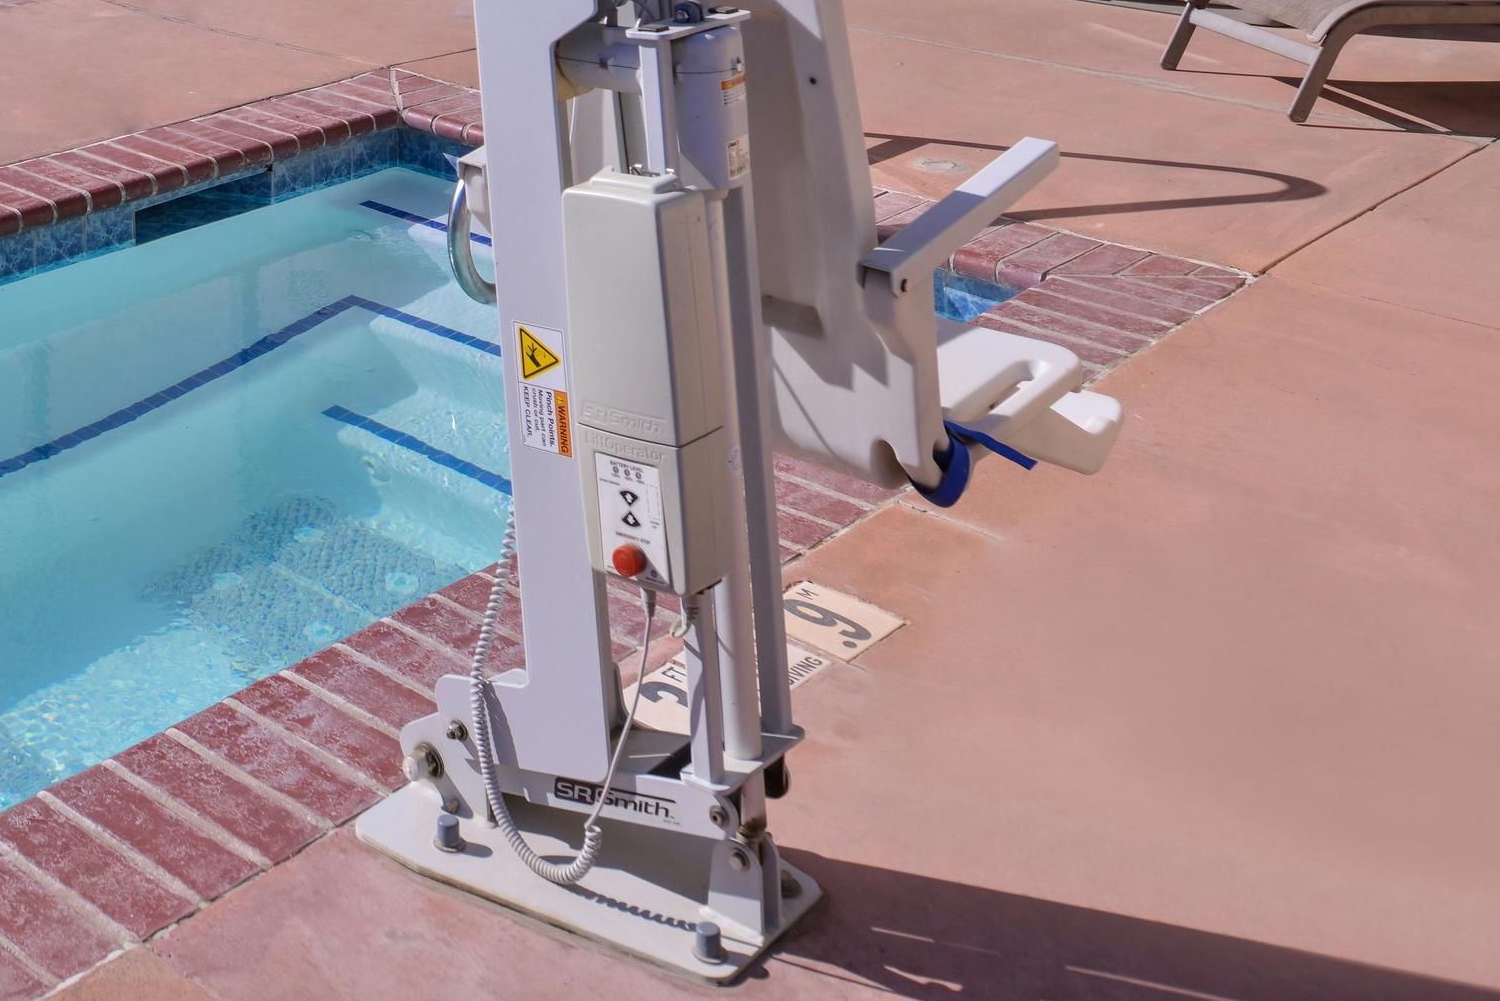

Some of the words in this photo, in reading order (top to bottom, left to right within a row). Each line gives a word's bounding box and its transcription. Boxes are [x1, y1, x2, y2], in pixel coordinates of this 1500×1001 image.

[523, 385, 531, 408] KEEP
[525, 408, 533, 437] CLEAR.
[558, 405, 569, 453] WARNING
[609, 409, 661, 433] Smith
[795, 587, 820, 601] M
[661, 666, 687, 683] FT
[556, 780, 595, 805] SR
[595, 787, 670, 819] Smith
